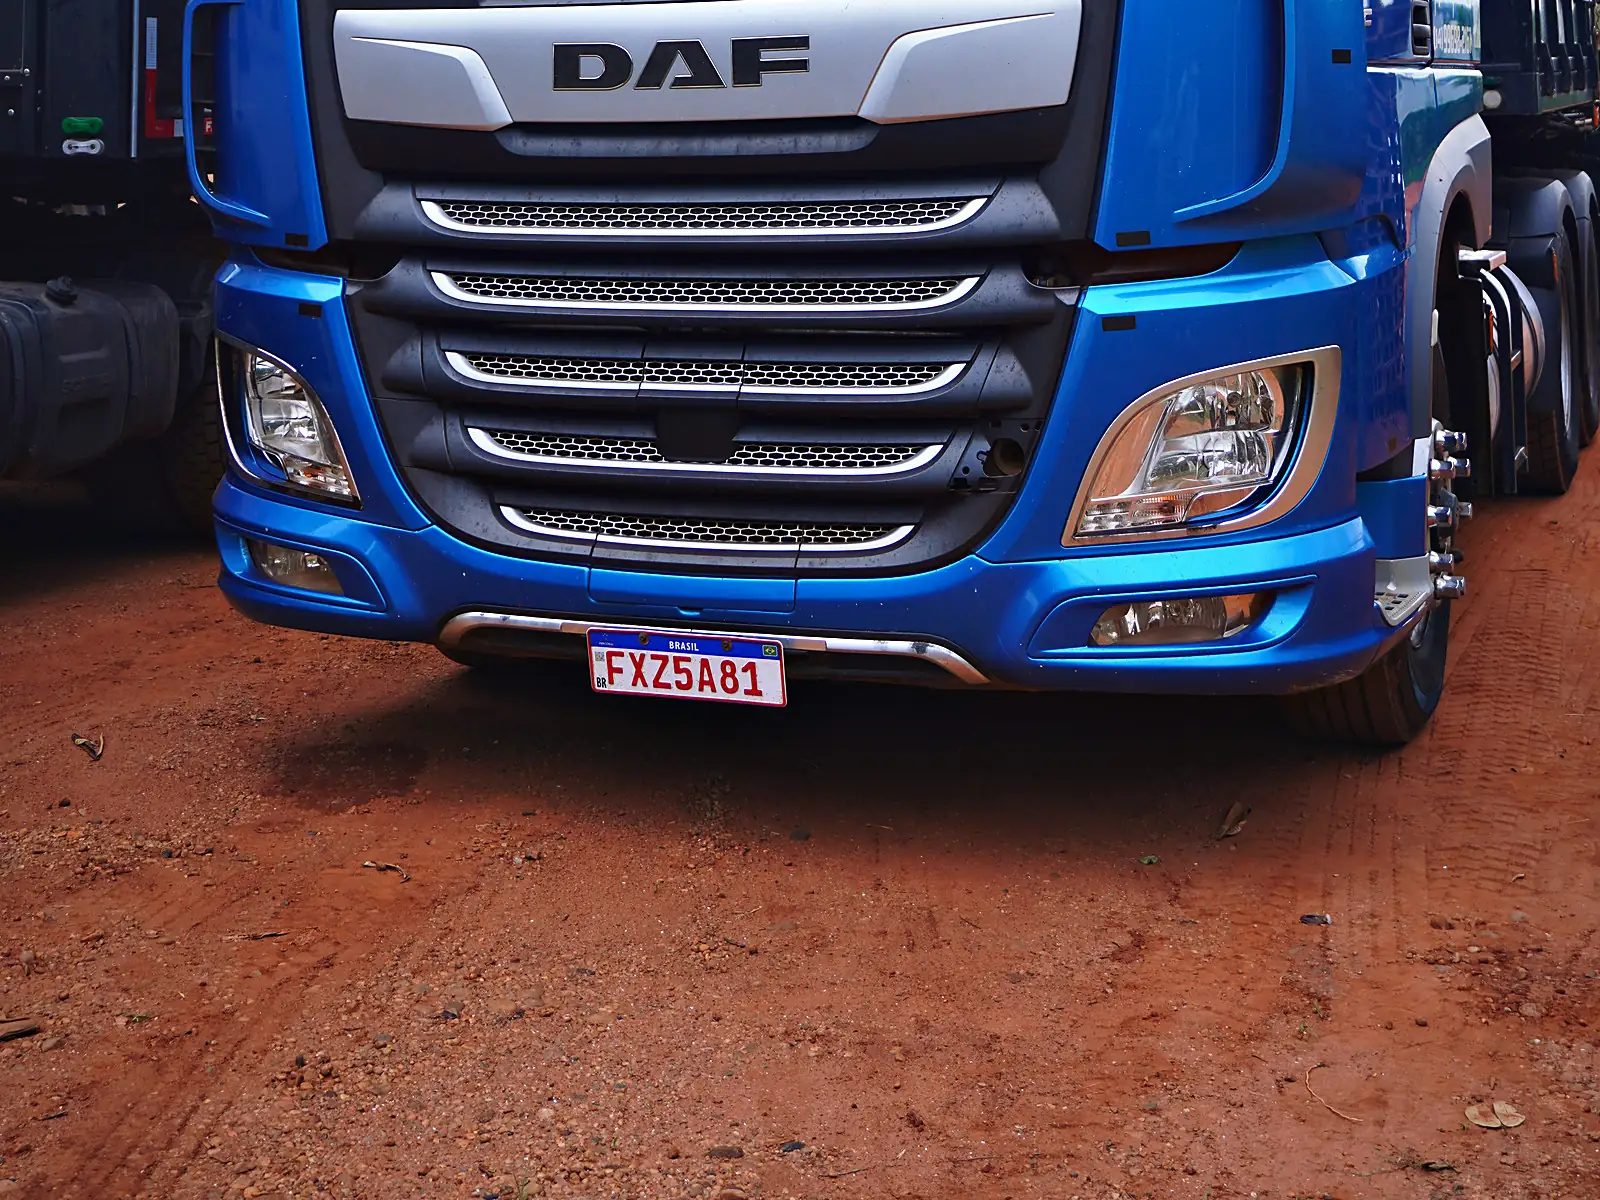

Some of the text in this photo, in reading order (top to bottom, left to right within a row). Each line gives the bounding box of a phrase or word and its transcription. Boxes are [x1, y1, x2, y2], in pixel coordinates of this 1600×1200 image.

[552, 35, 810, 91] DAF
[669, 640, 700, 652] BRASIL
[596, 677, 607, 688] BR
[605, 650, 763, 696] FXZ5A81
